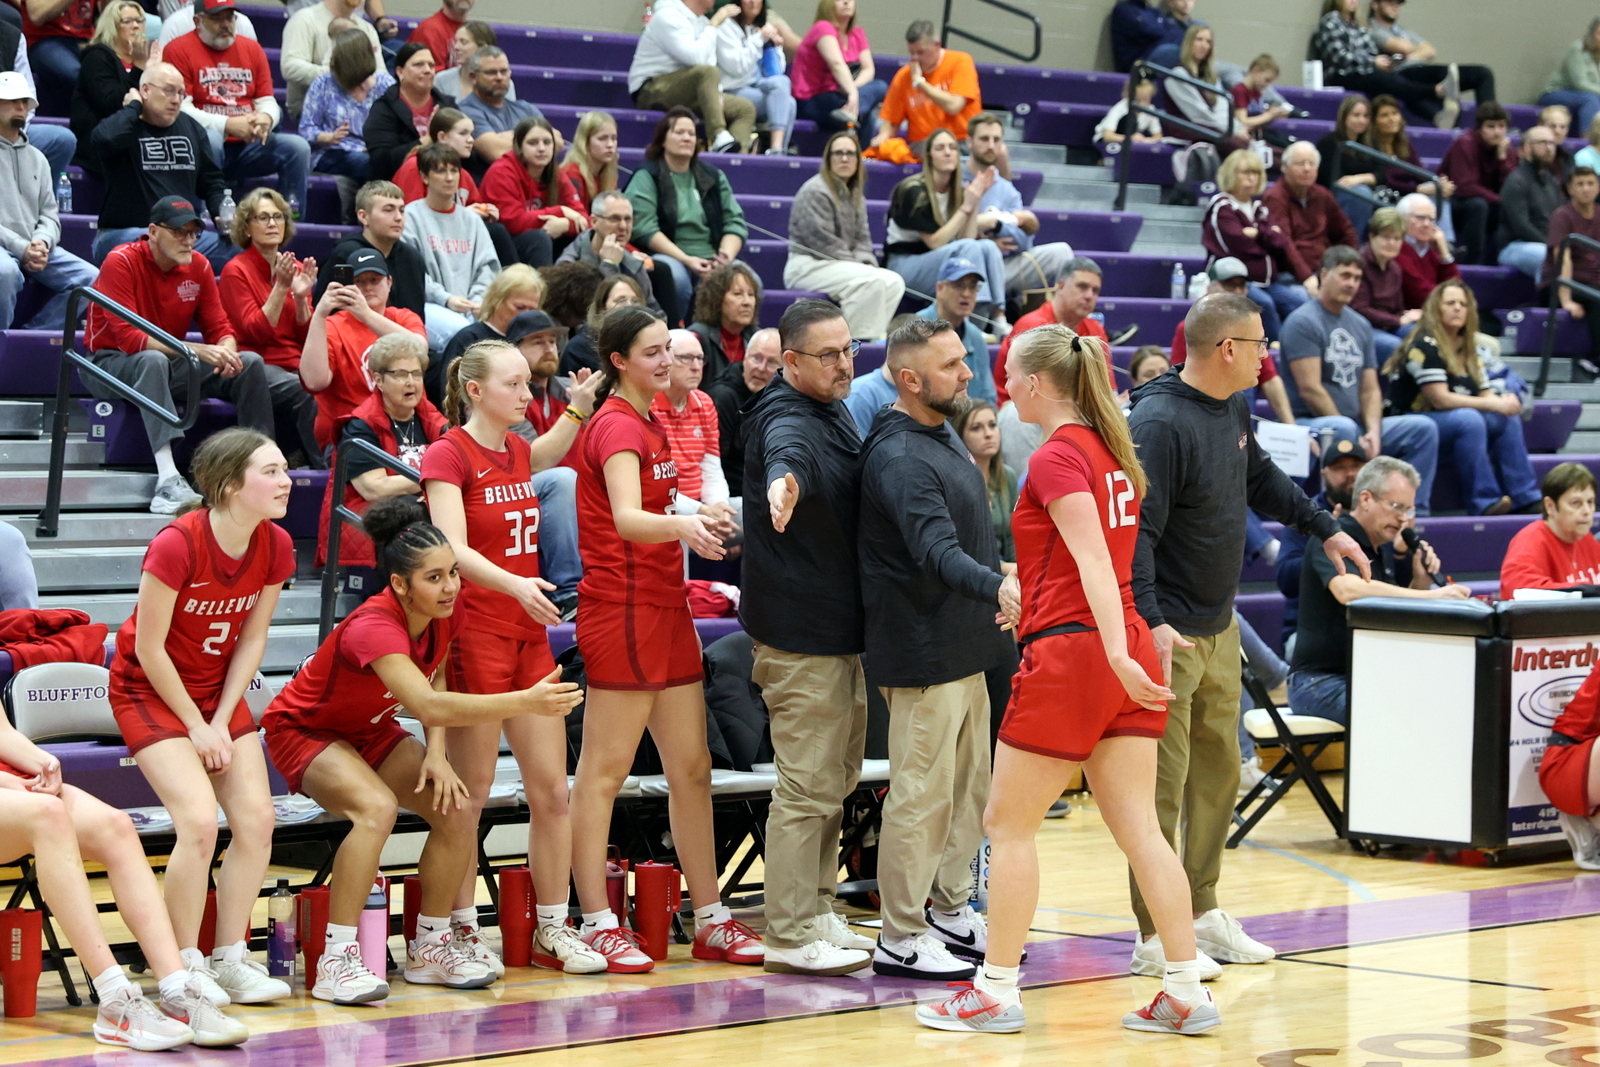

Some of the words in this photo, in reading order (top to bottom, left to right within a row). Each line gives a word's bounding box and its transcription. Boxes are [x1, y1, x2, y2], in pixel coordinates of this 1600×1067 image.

[96, 426, 101, 436] E
[1105, 470, 1136, 529] 12
[504, 507, 540, 557] 32
[352, 577, 359, 588] C
[26, 685, 109, 702] BLUFFTO
[125, 757, 133, 765] 16
[970, 855, 979, 901] POWERAD
